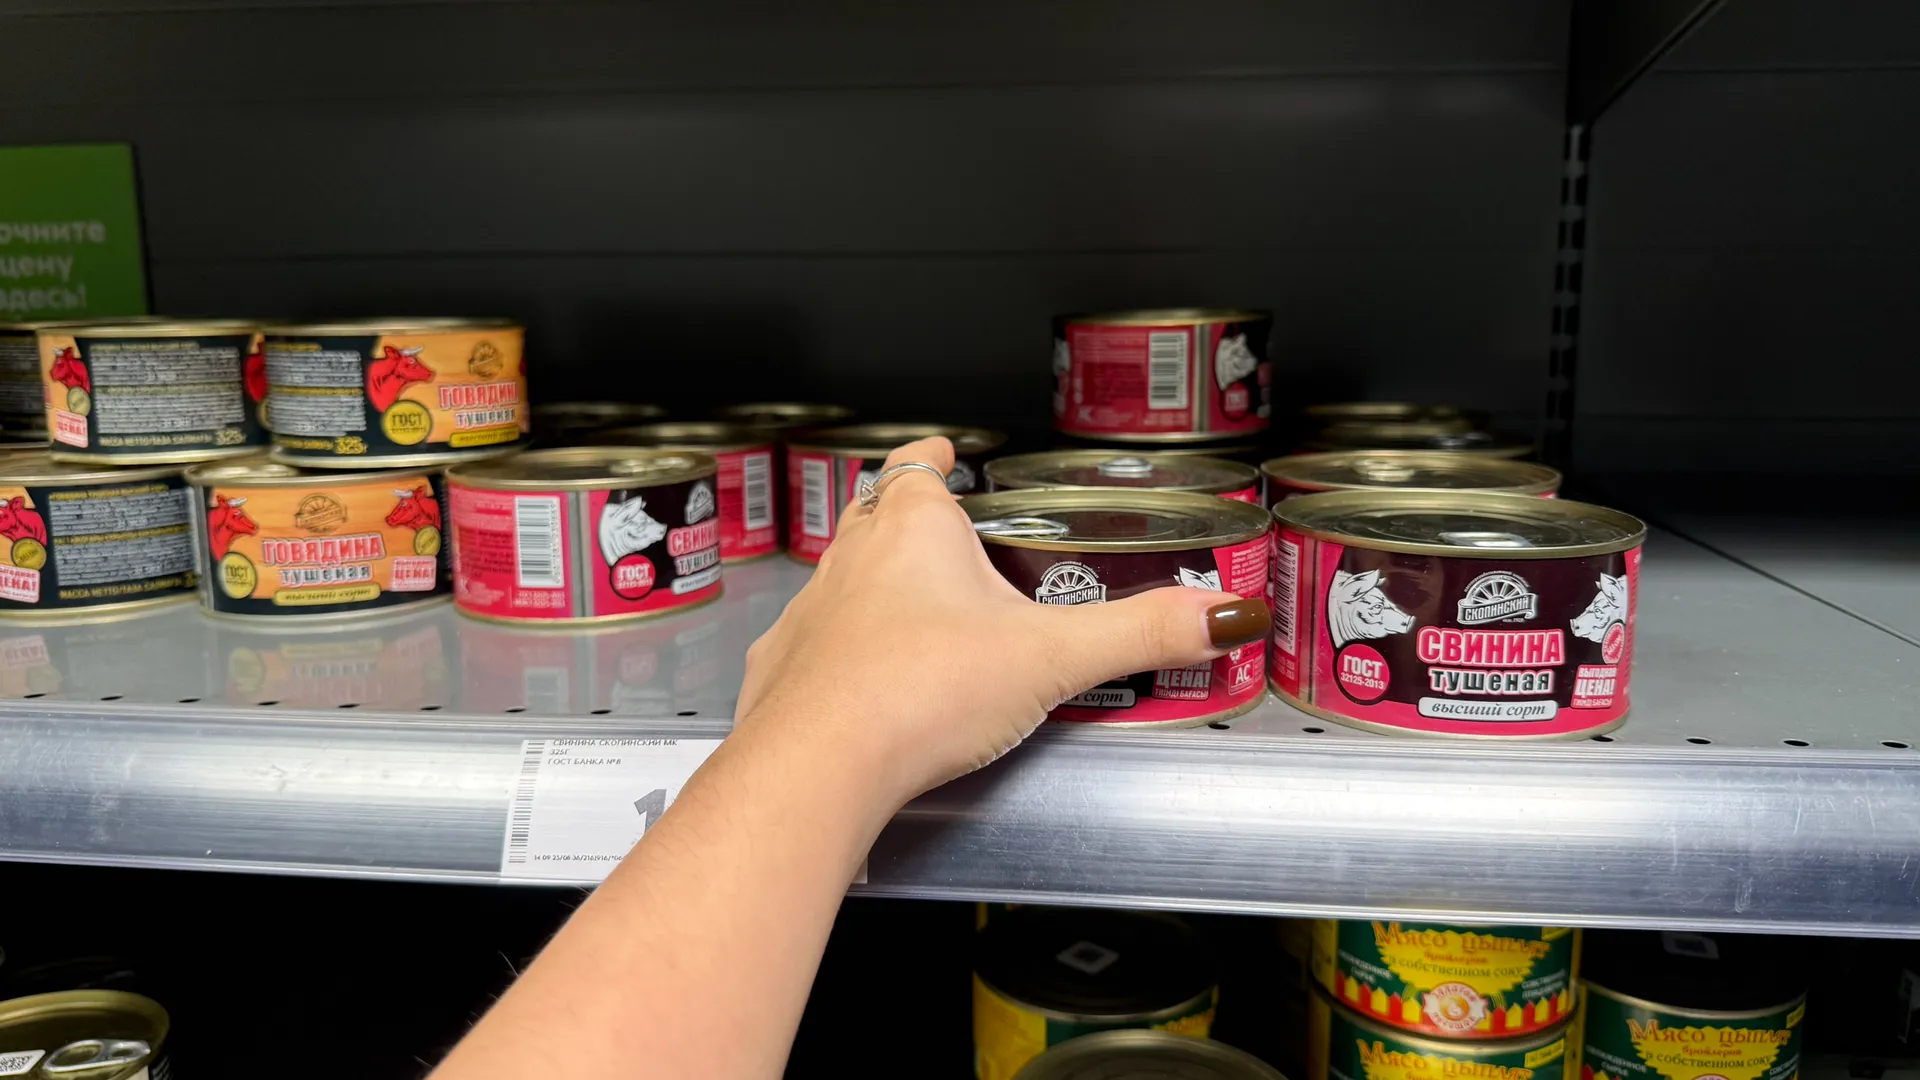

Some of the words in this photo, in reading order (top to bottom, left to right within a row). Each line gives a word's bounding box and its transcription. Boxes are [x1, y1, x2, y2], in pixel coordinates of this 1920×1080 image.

[391, 412, 424, 427] ГОСТ
[262, 534, 386, 565] ГОВЯДИНА
[225, 564, 249, 579] ГОСТ
[281, 564, 371, 586] тушеная
[620, 563, 651, 581] ГОСТ
[1042, 585, 1100, 605] СКОПИНСКИЙ
[1465, 595, 1529, 621] СКОПИНСКИЙ
[1418, 629, 1563, 665] СВИНИНА
[1343, 654, 1383, 679] ГОСТ
[1156, 670, 1210, 689] ЦЕНА!
[1341, 672, 1384, 690] 32125-2013
[1430, 669, 1553, 694] тушеная
[1574, 679, 1615, 698] ЦЕНА!
[1084, 693, 1124, 706] сорт
[1432, 702, 1502, 716] высший
[1506, 705, 1546, 718] сорт
[553, 739, 597, 747] СВИНИНА
[600, 739, 661, 747] СКОПИНСКИЙ
[664, 739, 678, 747] МК
[547, 758, 572, 766] ГОСТ
[574, 758, 604, 766] БАНКА
[633, 788, 667, 835] 1
[1371, 920, 1448, 947] Мясо
[1461, 934, 1551, 959] цыплят
[1399, 956, 1492, 979] собственном
[1493, 966, 1524, 979] соку
[1626, 1018, 1706, 1043] Мясо
[1719, 1030, 1792, 1048] цыплят
[1356, 1039, 1428, 1069] Мясо
[1656, 1053, 1745, 1069] собственном
[1747, 1056, 1772, 1067] соку
